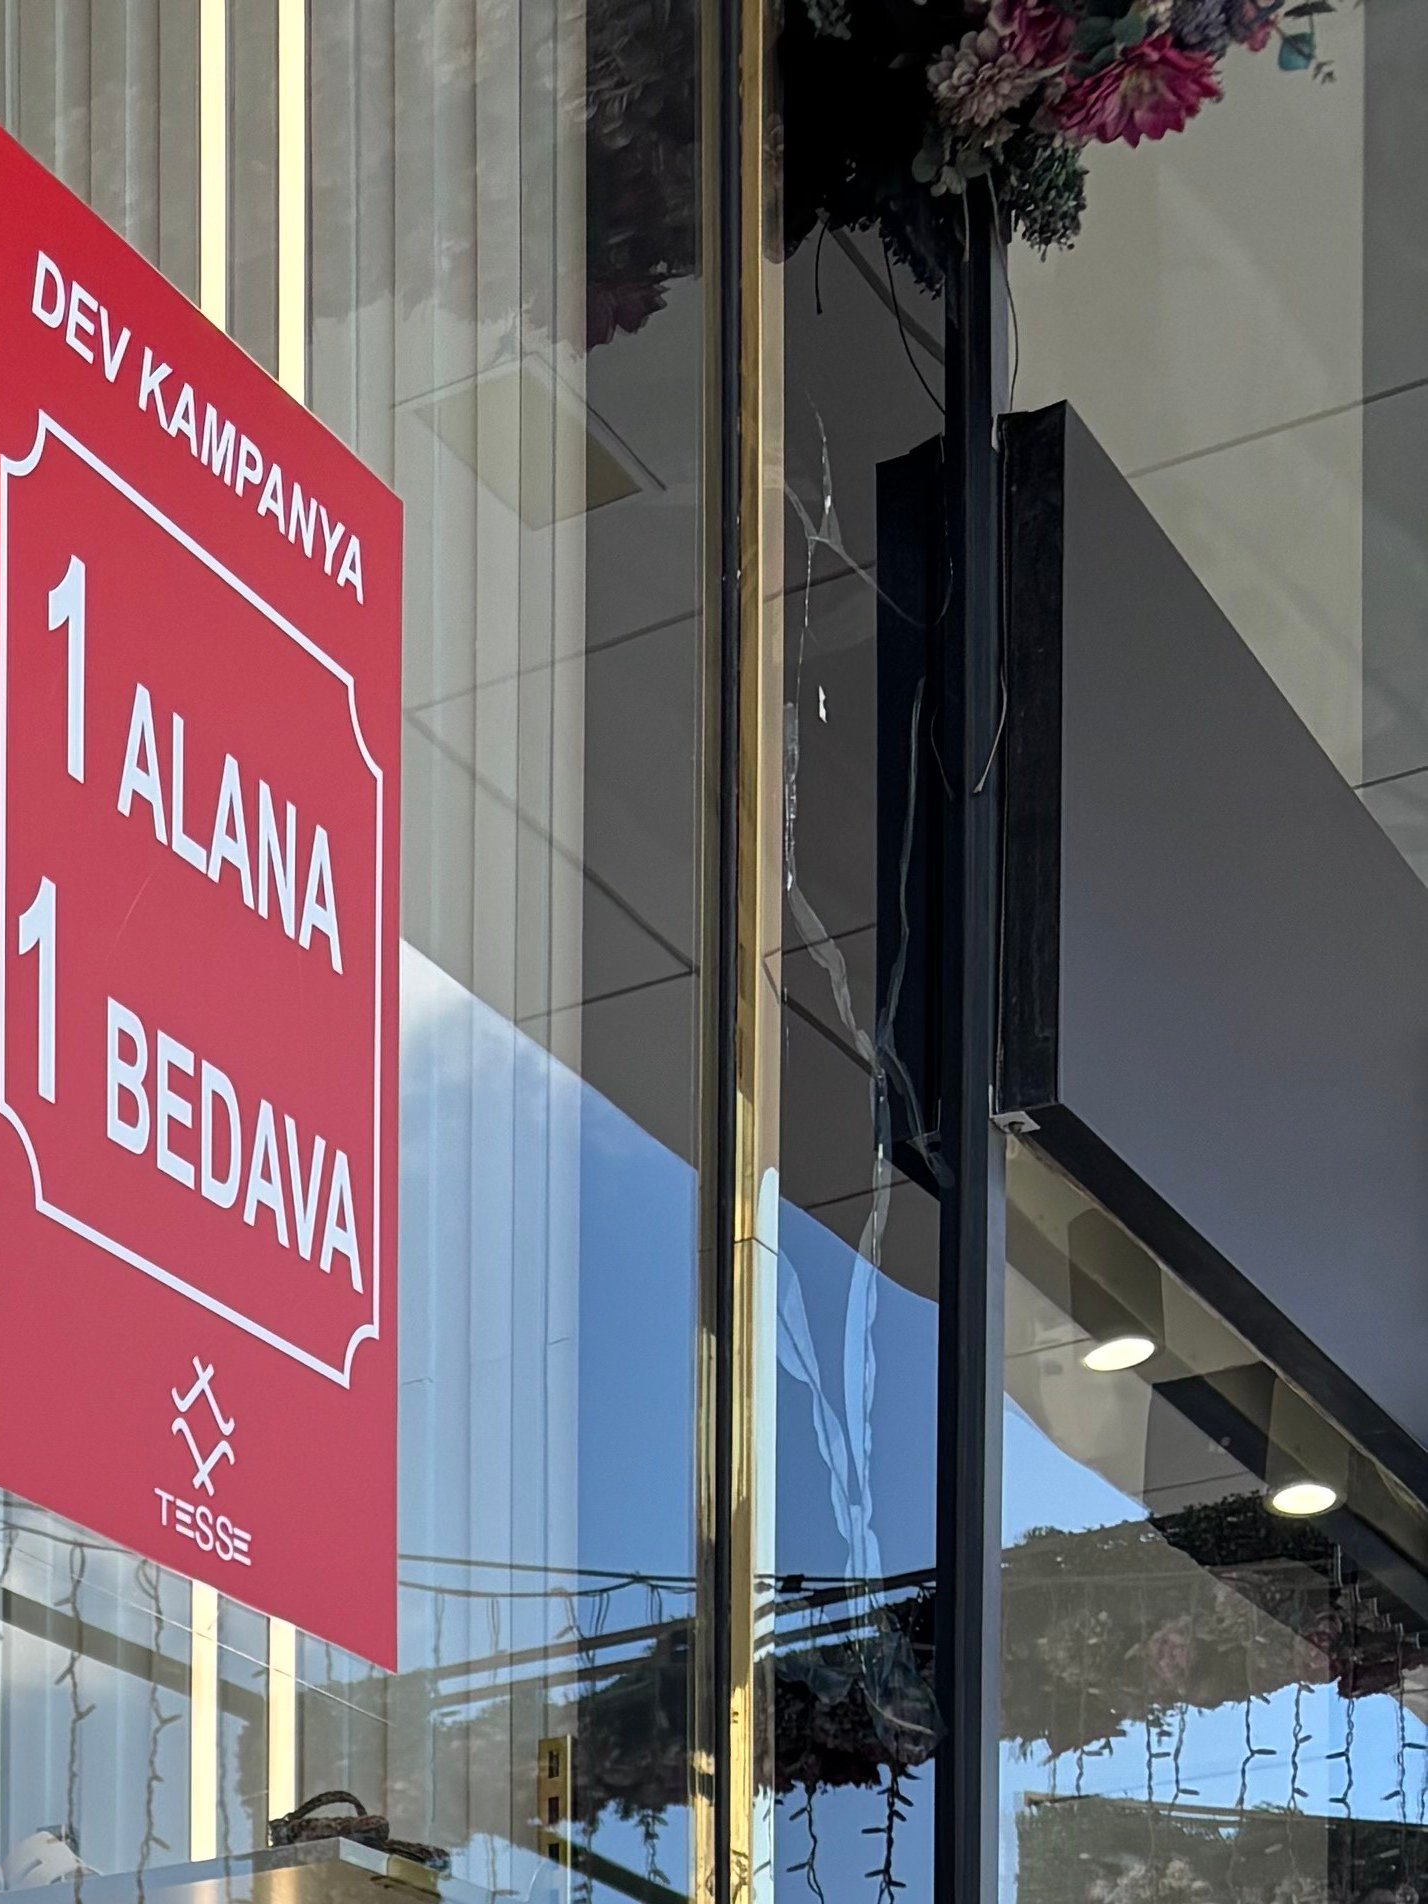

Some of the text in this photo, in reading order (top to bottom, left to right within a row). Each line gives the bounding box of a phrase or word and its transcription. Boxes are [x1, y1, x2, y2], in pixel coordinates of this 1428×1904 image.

[31, 250, 364, 605] DEV KAMPANYA
[48, 554, 344, 975] 1 ALANA
[18, 875, 364, 1294] 1 BEDAVA
[154, 1487, 252, 1566] TESSE
